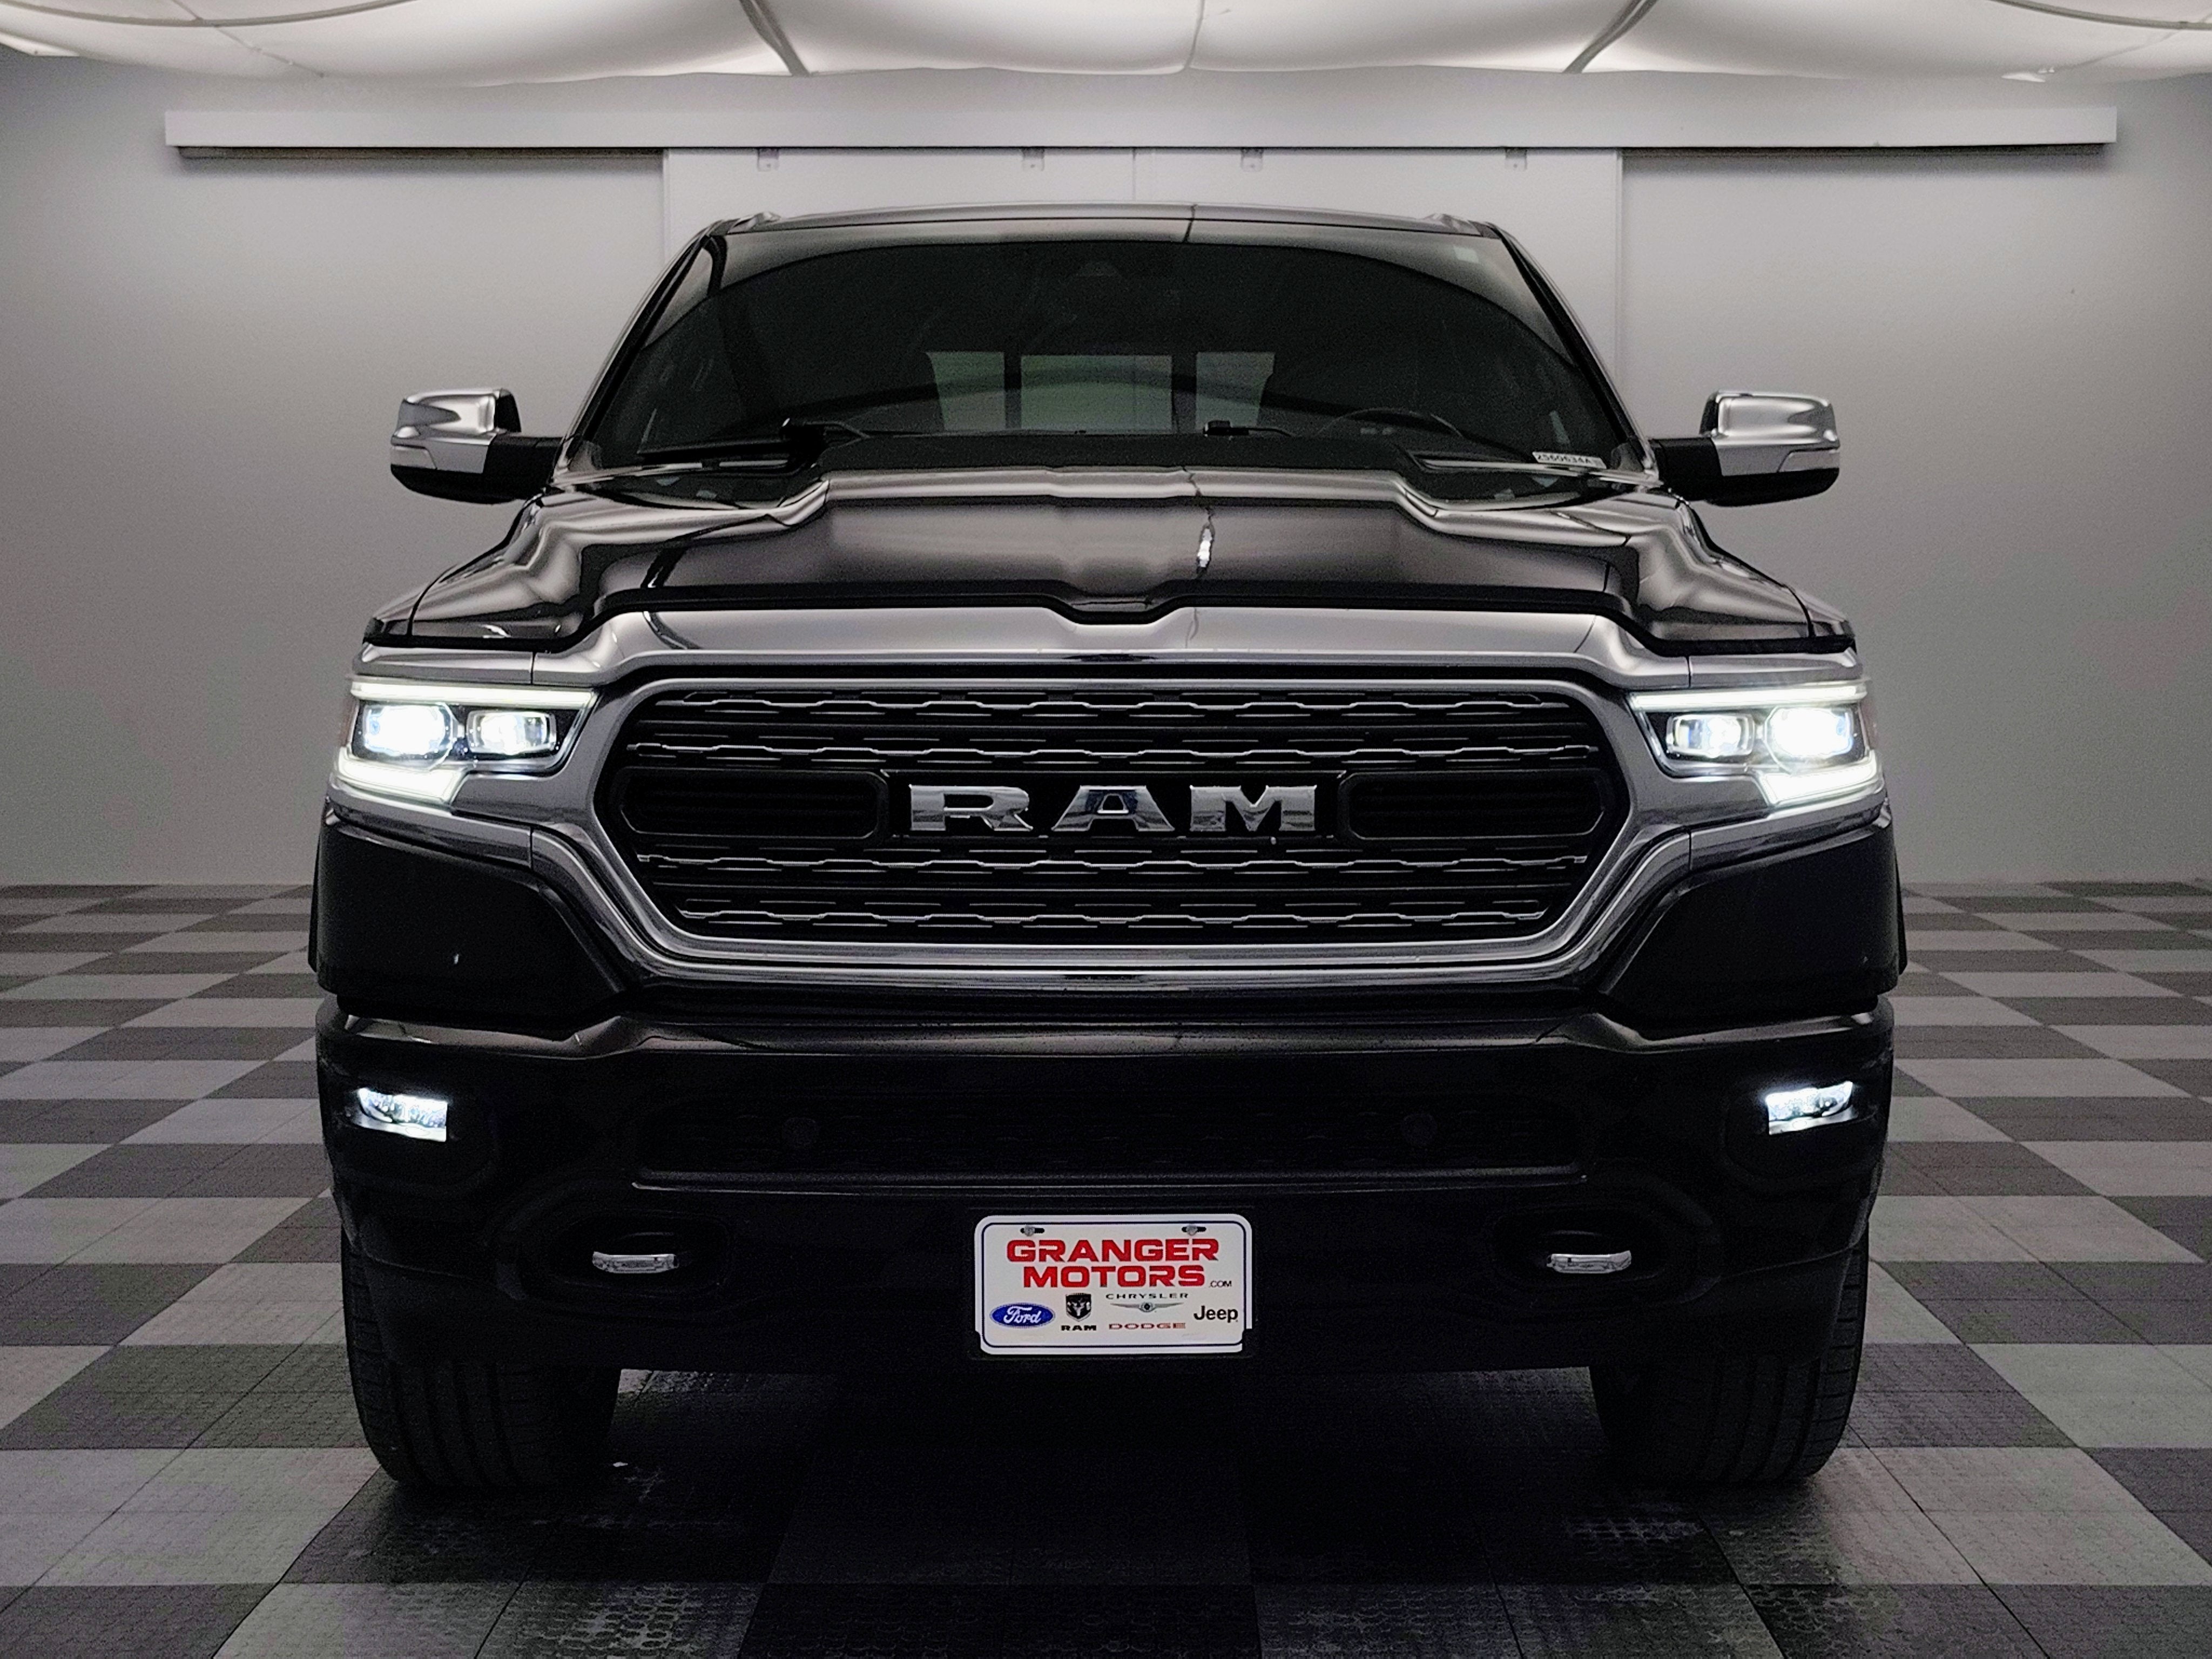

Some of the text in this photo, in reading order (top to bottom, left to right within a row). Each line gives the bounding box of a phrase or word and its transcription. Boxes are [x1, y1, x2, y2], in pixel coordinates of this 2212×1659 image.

[909, 784, 1317, 832] RAM
[1006, 1238, 1219, 1262] GRANGER
[1023, 1265, 1205, 1287] MOTORS
[1003, 1305, 1042, 1324] Ford
[1193, 1305, 1238, 1323] Jeep
